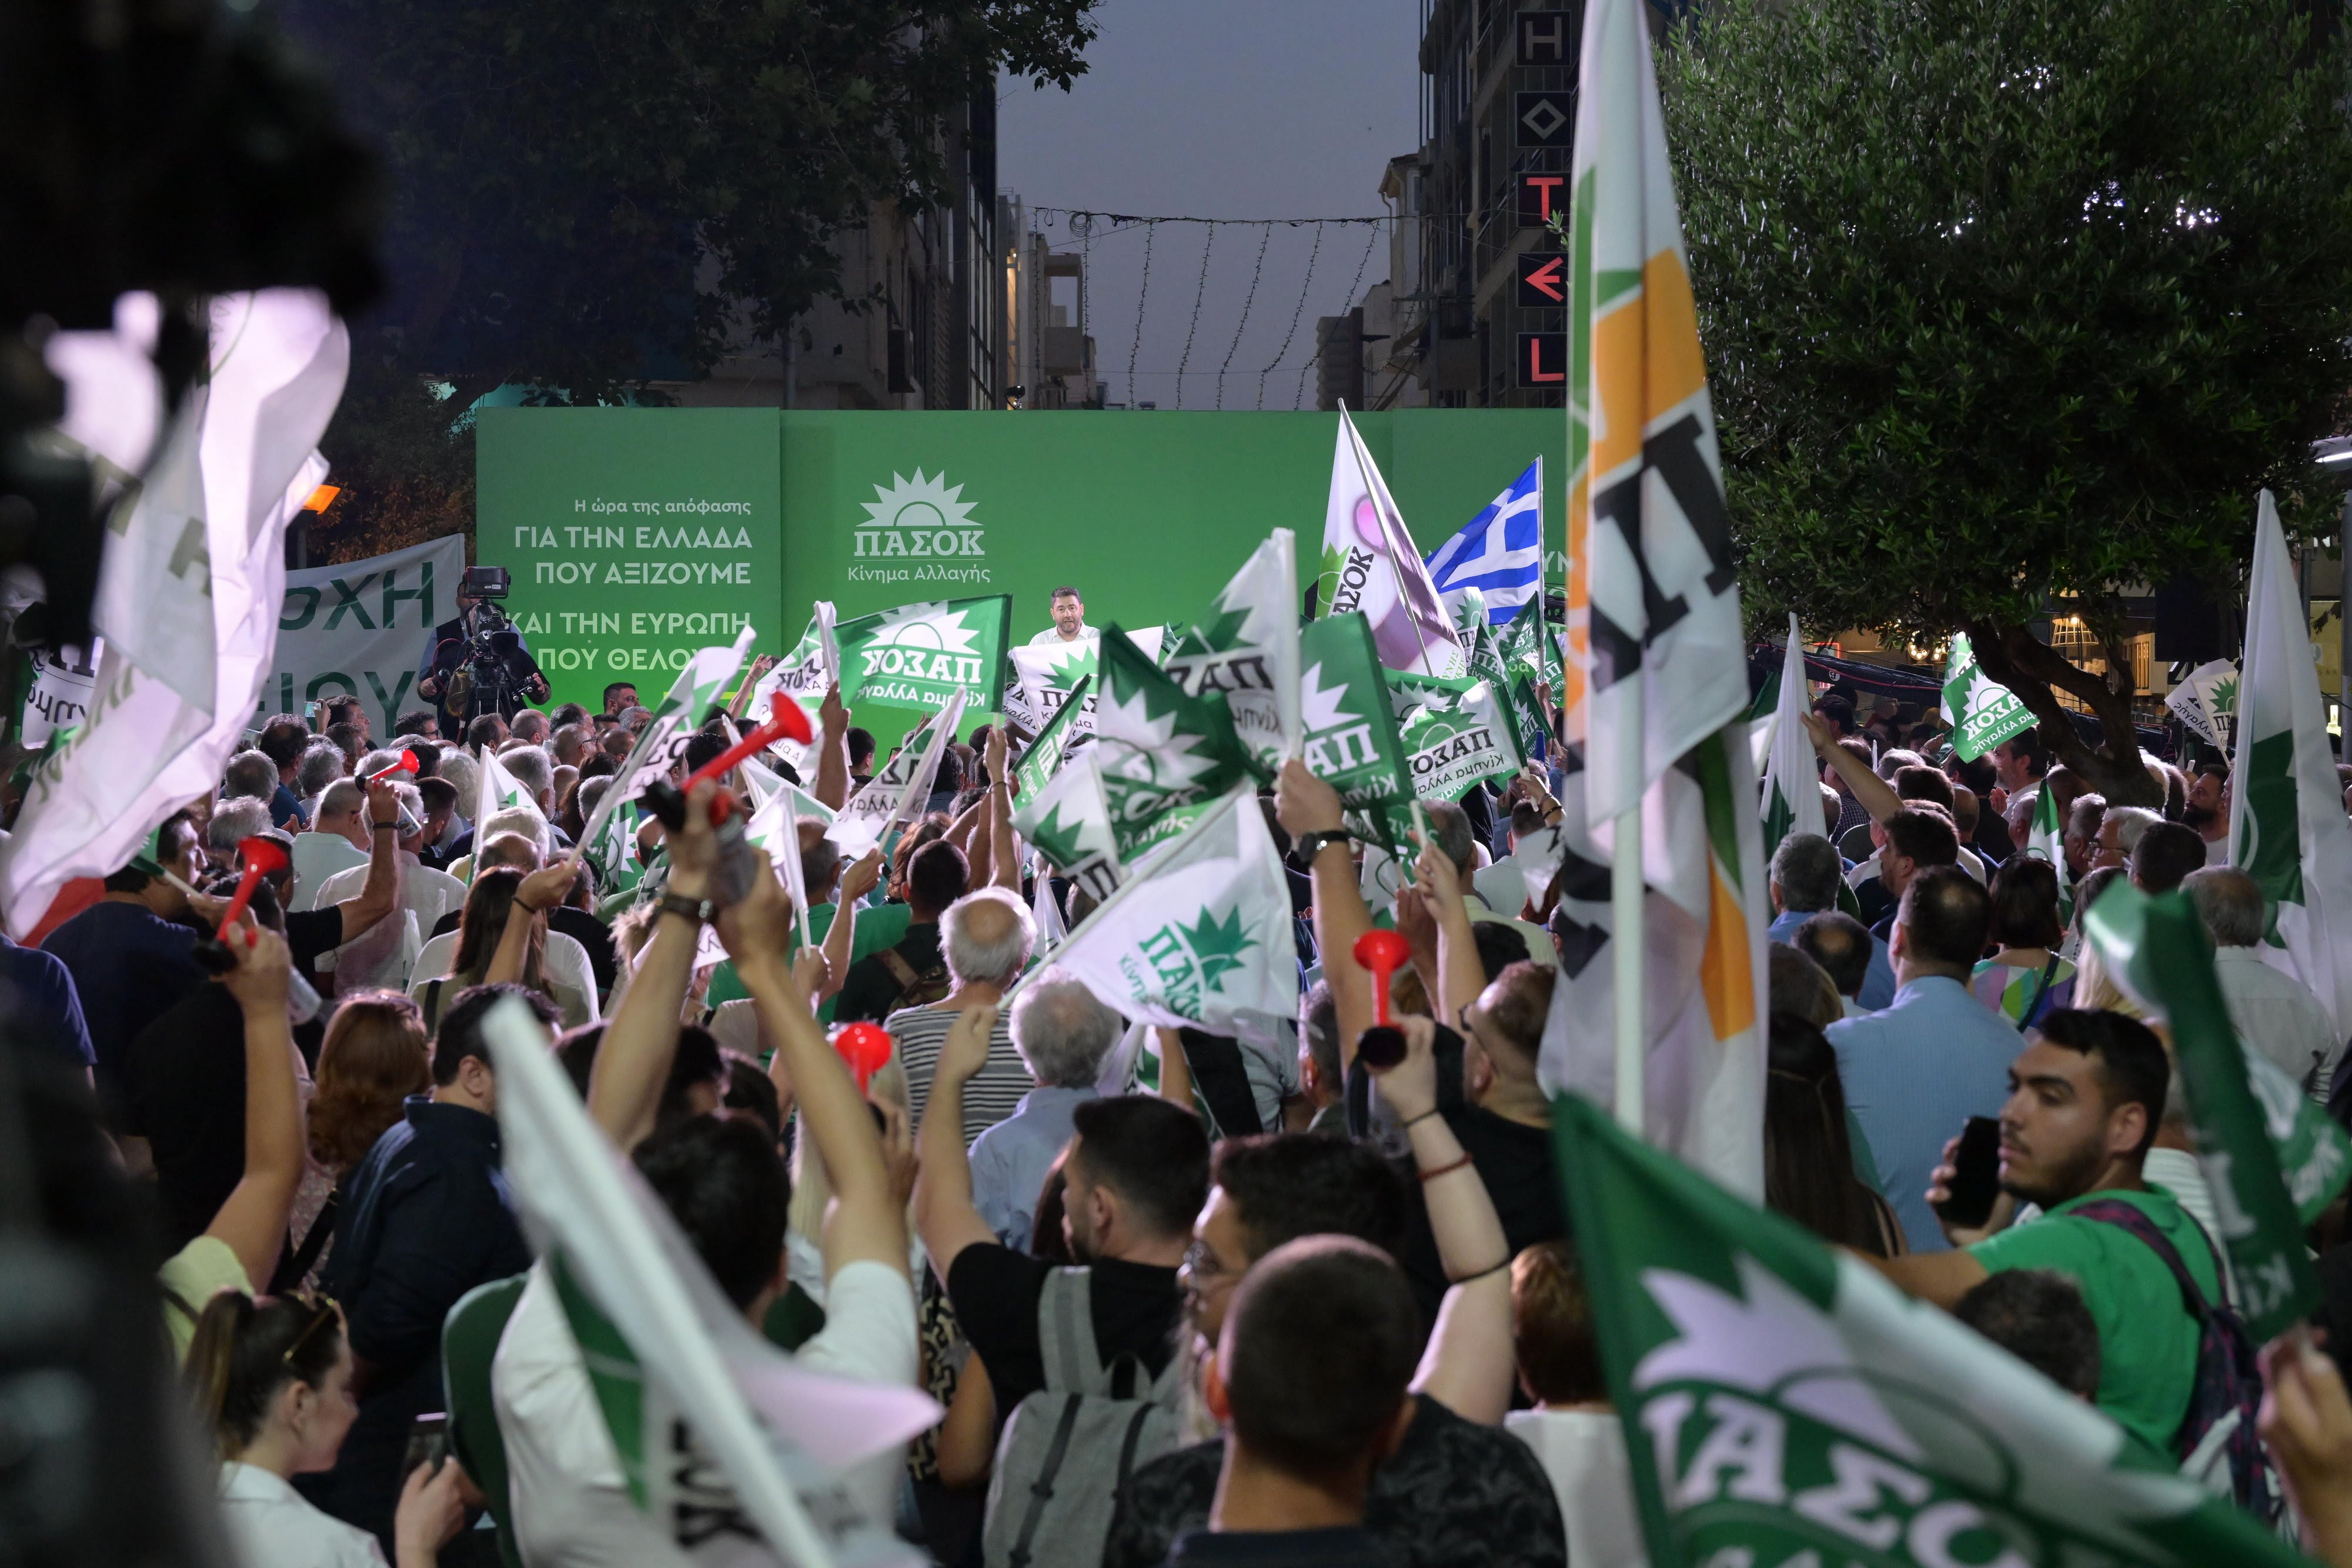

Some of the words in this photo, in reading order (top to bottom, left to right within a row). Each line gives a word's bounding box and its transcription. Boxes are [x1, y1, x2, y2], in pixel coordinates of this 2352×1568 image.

[574, 499, 586, 512] Η
[592, 497, 627, 515] ώρα
[632, 502, 660, 515] της
[665, 498, 751, 515] απόφασης
[514, 526, 558, 548] ΓΙΑ
[564, 526, 624, 548] ΤΗΝ
[636, 526, 753, 548] ΕΛΛΑΔΑ
[854, 530, 985, 556] ΠΑΣΟΚ
[536, 562, 597, 584] ΠΟΥ
[603, 561, 751, 584] ΑΞΙΖΟΥΜΕ
[848, 564, 910, 584] Κίνημα
[914, 564, 991, 583] Αλλαγής
[1331, 546, 1375, 617] ΑΣΟΚ
[506, 612, 551, 634] ΚΑΙ
[559, 613, 620, 634] ΤΗΝ
[631, 612, 750, 634] ΕΥΡΩΠΗ
[537, 648, 599, 670] ΠΟΥ
[607, 648, 751, 670] ΘΕΛΟ
